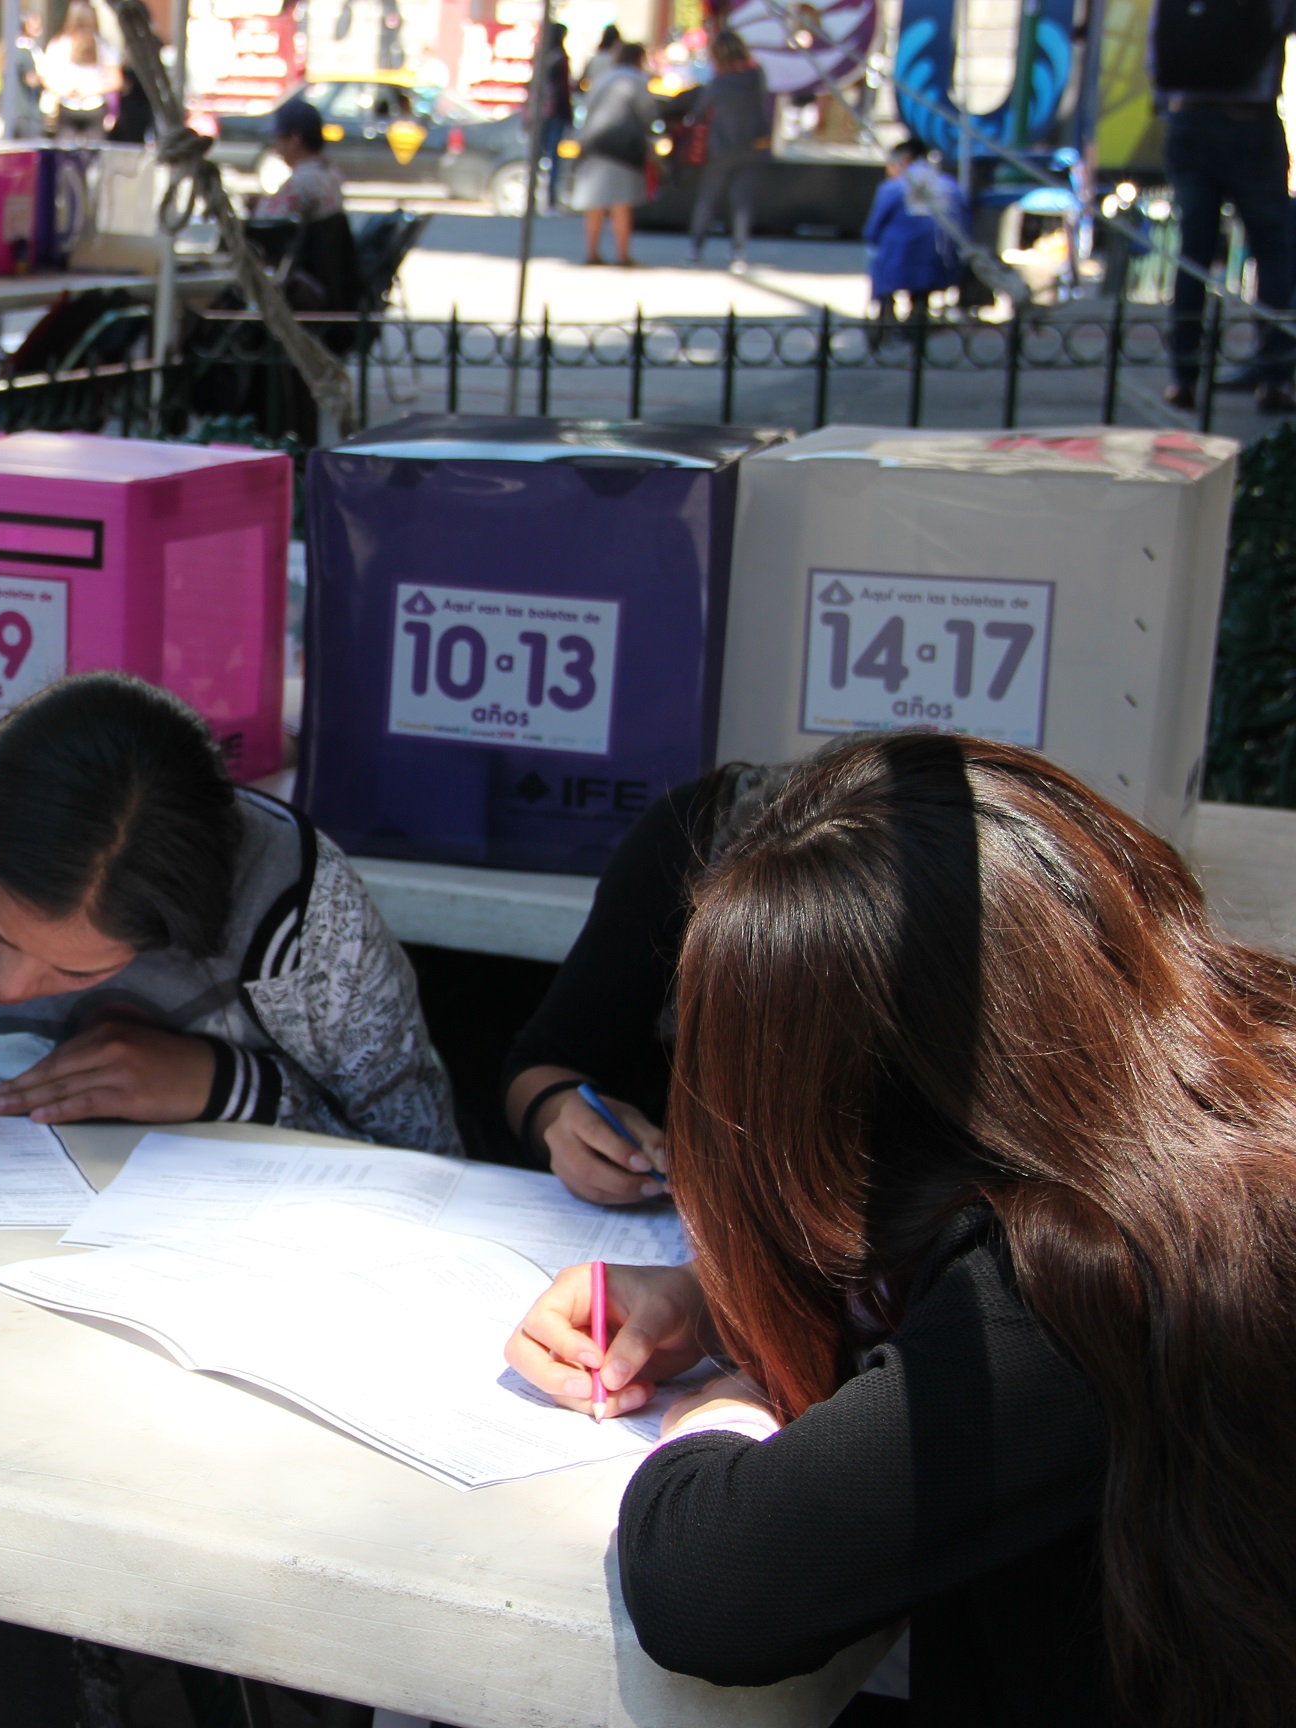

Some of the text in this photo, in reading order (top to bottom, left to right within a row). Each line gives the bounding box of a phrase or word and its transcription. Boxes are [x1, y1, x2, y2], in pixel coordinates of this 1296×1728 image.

[860, 586, 1029, 610] Aquí van las boletas de
[441, 599, 601, 624] Aquí van las boletas de
[403, 621, 597, 712] 10 a 13
[820, 611, 1035, 702] 14 a 17
[471, 704, 530, 727] años
[892, 695, 954, 720] años
[562, 776, 649, 813] IFE
